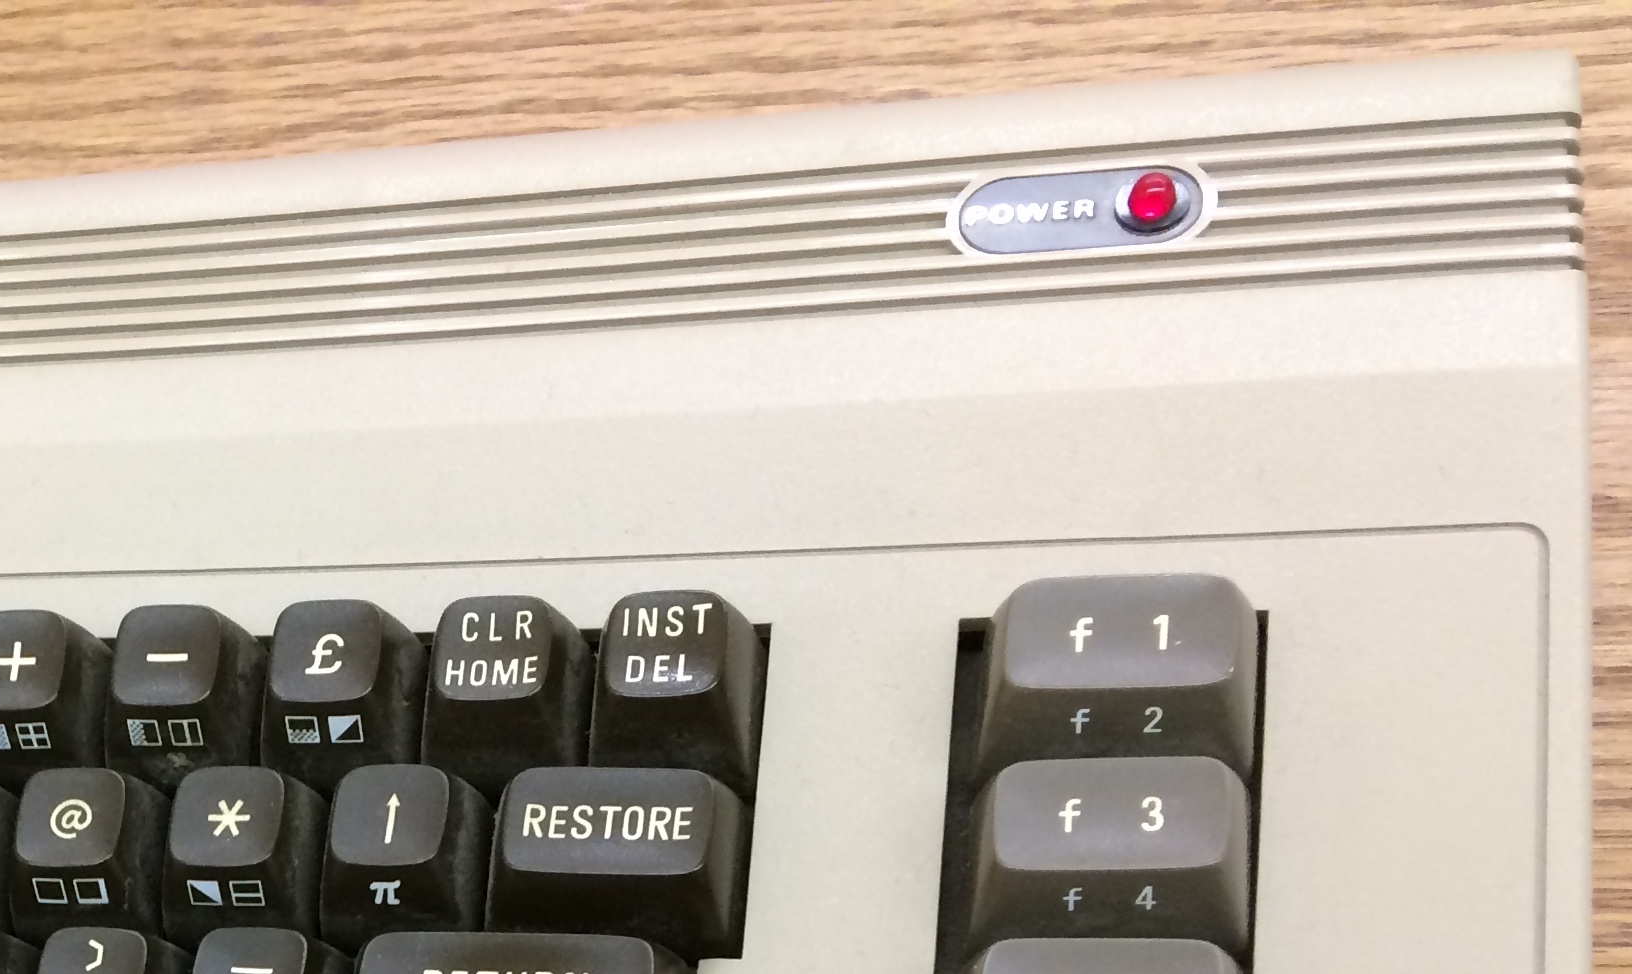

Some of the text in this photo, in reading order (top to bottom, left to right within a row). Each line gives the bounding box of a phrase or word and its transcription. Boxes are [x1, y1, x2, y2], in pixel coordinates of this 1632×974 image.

[963, 197, 1096, 227] POWER
[461, 610, 533, 642] CLR
[622, 602, 713, 637] INST
[304, 633, 345, 675] £
[624, 653, 693, 683] DEL
[444, 655, 538, 687] HOME
[49, 799, 93, 840] @
[522, 803, 693, 841] RESTORE
[369, 879, 401, 905] π
